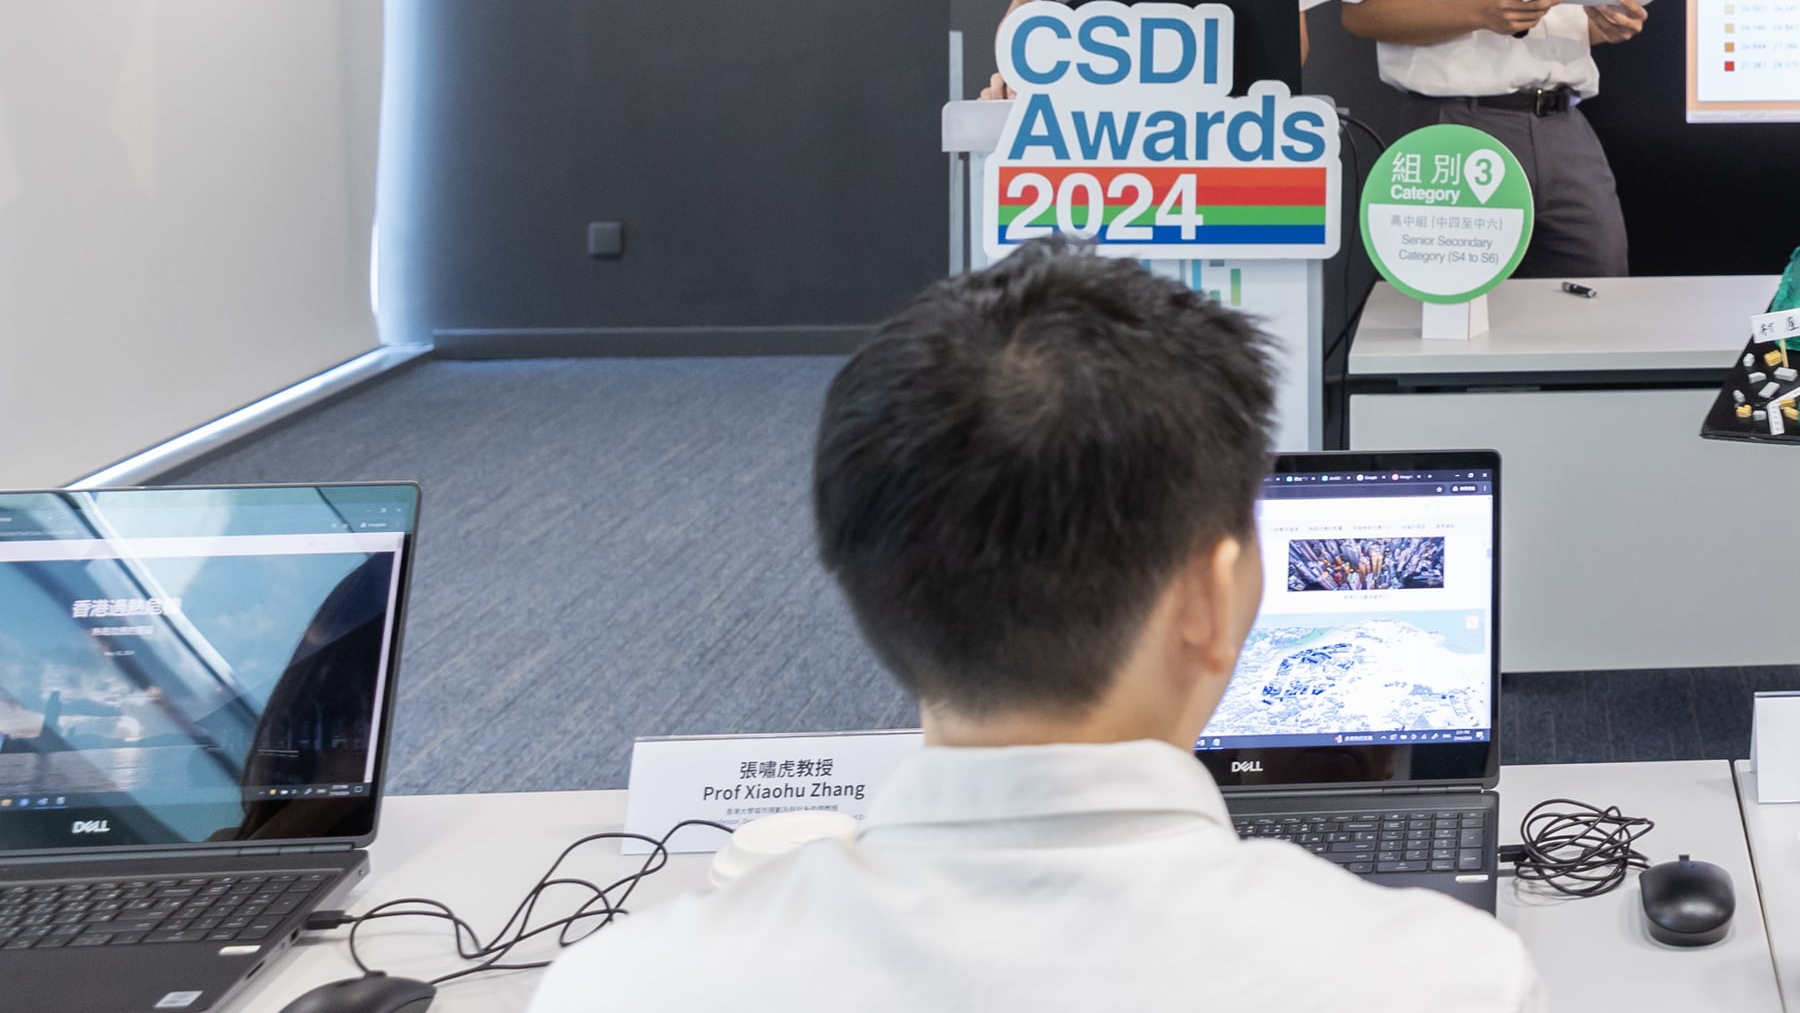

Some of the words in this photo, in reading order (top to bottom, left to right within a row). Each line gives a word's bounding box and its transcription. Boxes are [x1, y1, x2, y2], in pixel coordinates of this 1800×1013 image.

[1010, 15, 1218, 86] CSDI
[1008, 93, 1326, 163] Awards
[1474, 158, 1493, 186] 3
[1390, 184, 1460, 205] Category
[1005, 172, 1203, 241] 2024
[1401, 234, 1435, 246] Senior
[1437, 235, 1493, 250] Secondary
[1398, 249, 1446, 264] Category
[1448, 251, 1466, 264] (S4
[1468, 253, 1479, 263] to
[1481, 253, 1499, 265] S6)
[740, 758, 834, 780] 張嘯虎教授
[1231, 760, 1264, 773] DELL
[703, 784, 740, 801] Prof
[744, 783, 806, 800] Xiaohu
[810, 782, 866, 800] Zhang
[72, 820, 110, 834] DELL
